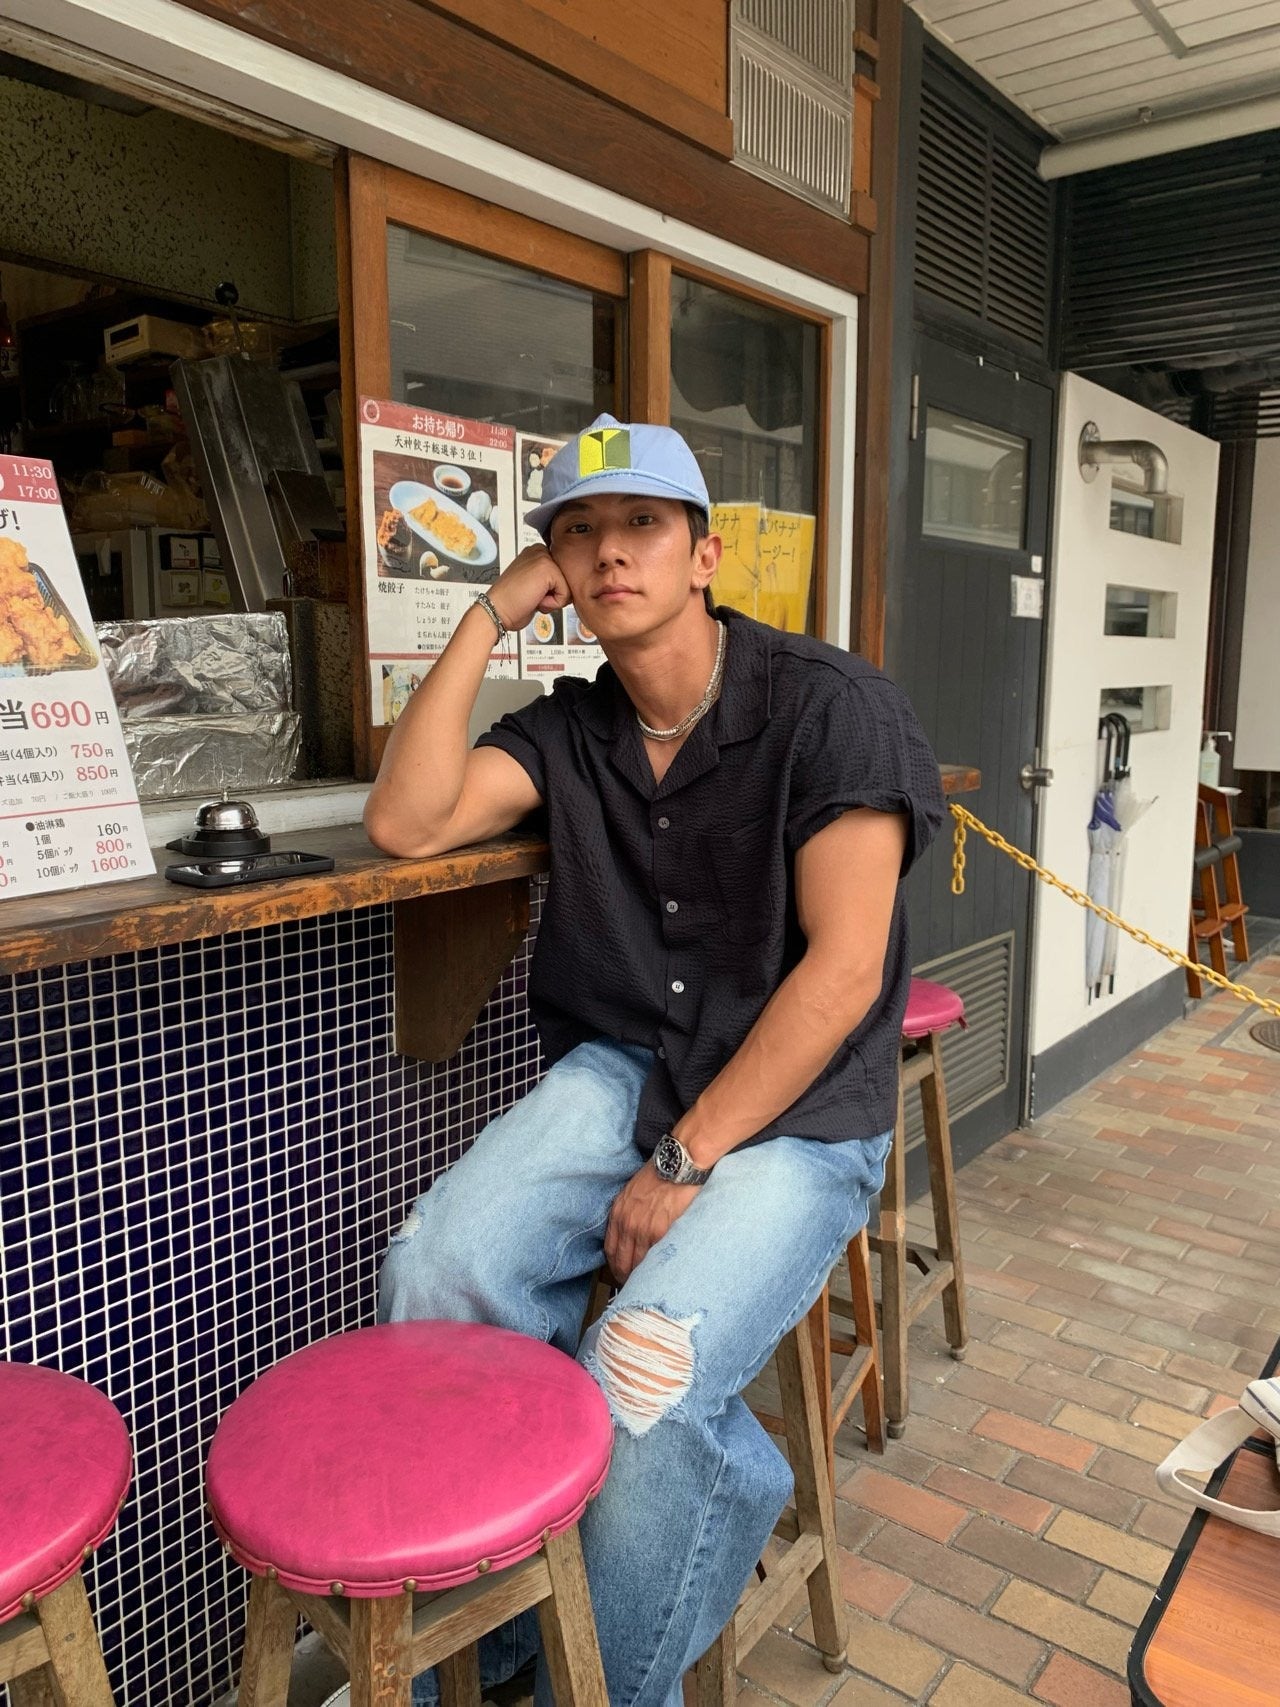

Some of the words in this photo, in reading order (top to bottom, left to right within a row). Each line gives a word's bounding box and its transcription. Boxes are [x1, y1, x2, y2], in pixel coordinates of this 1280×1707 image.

[412, 414, 465, 440] お持ち帰り
[490, 425, 508, 437] 11:30
[12, 463, 52, 480] 11:30
[17, 484, 57, 500] 17:00
[70, 742, 114, 759] 750円
[76, 764, 119, 782] 850円
[97, 822, 129, 837] 160円
[96, 838, 133, 855] 800円
[91, 854, 137, 874] 1600円
